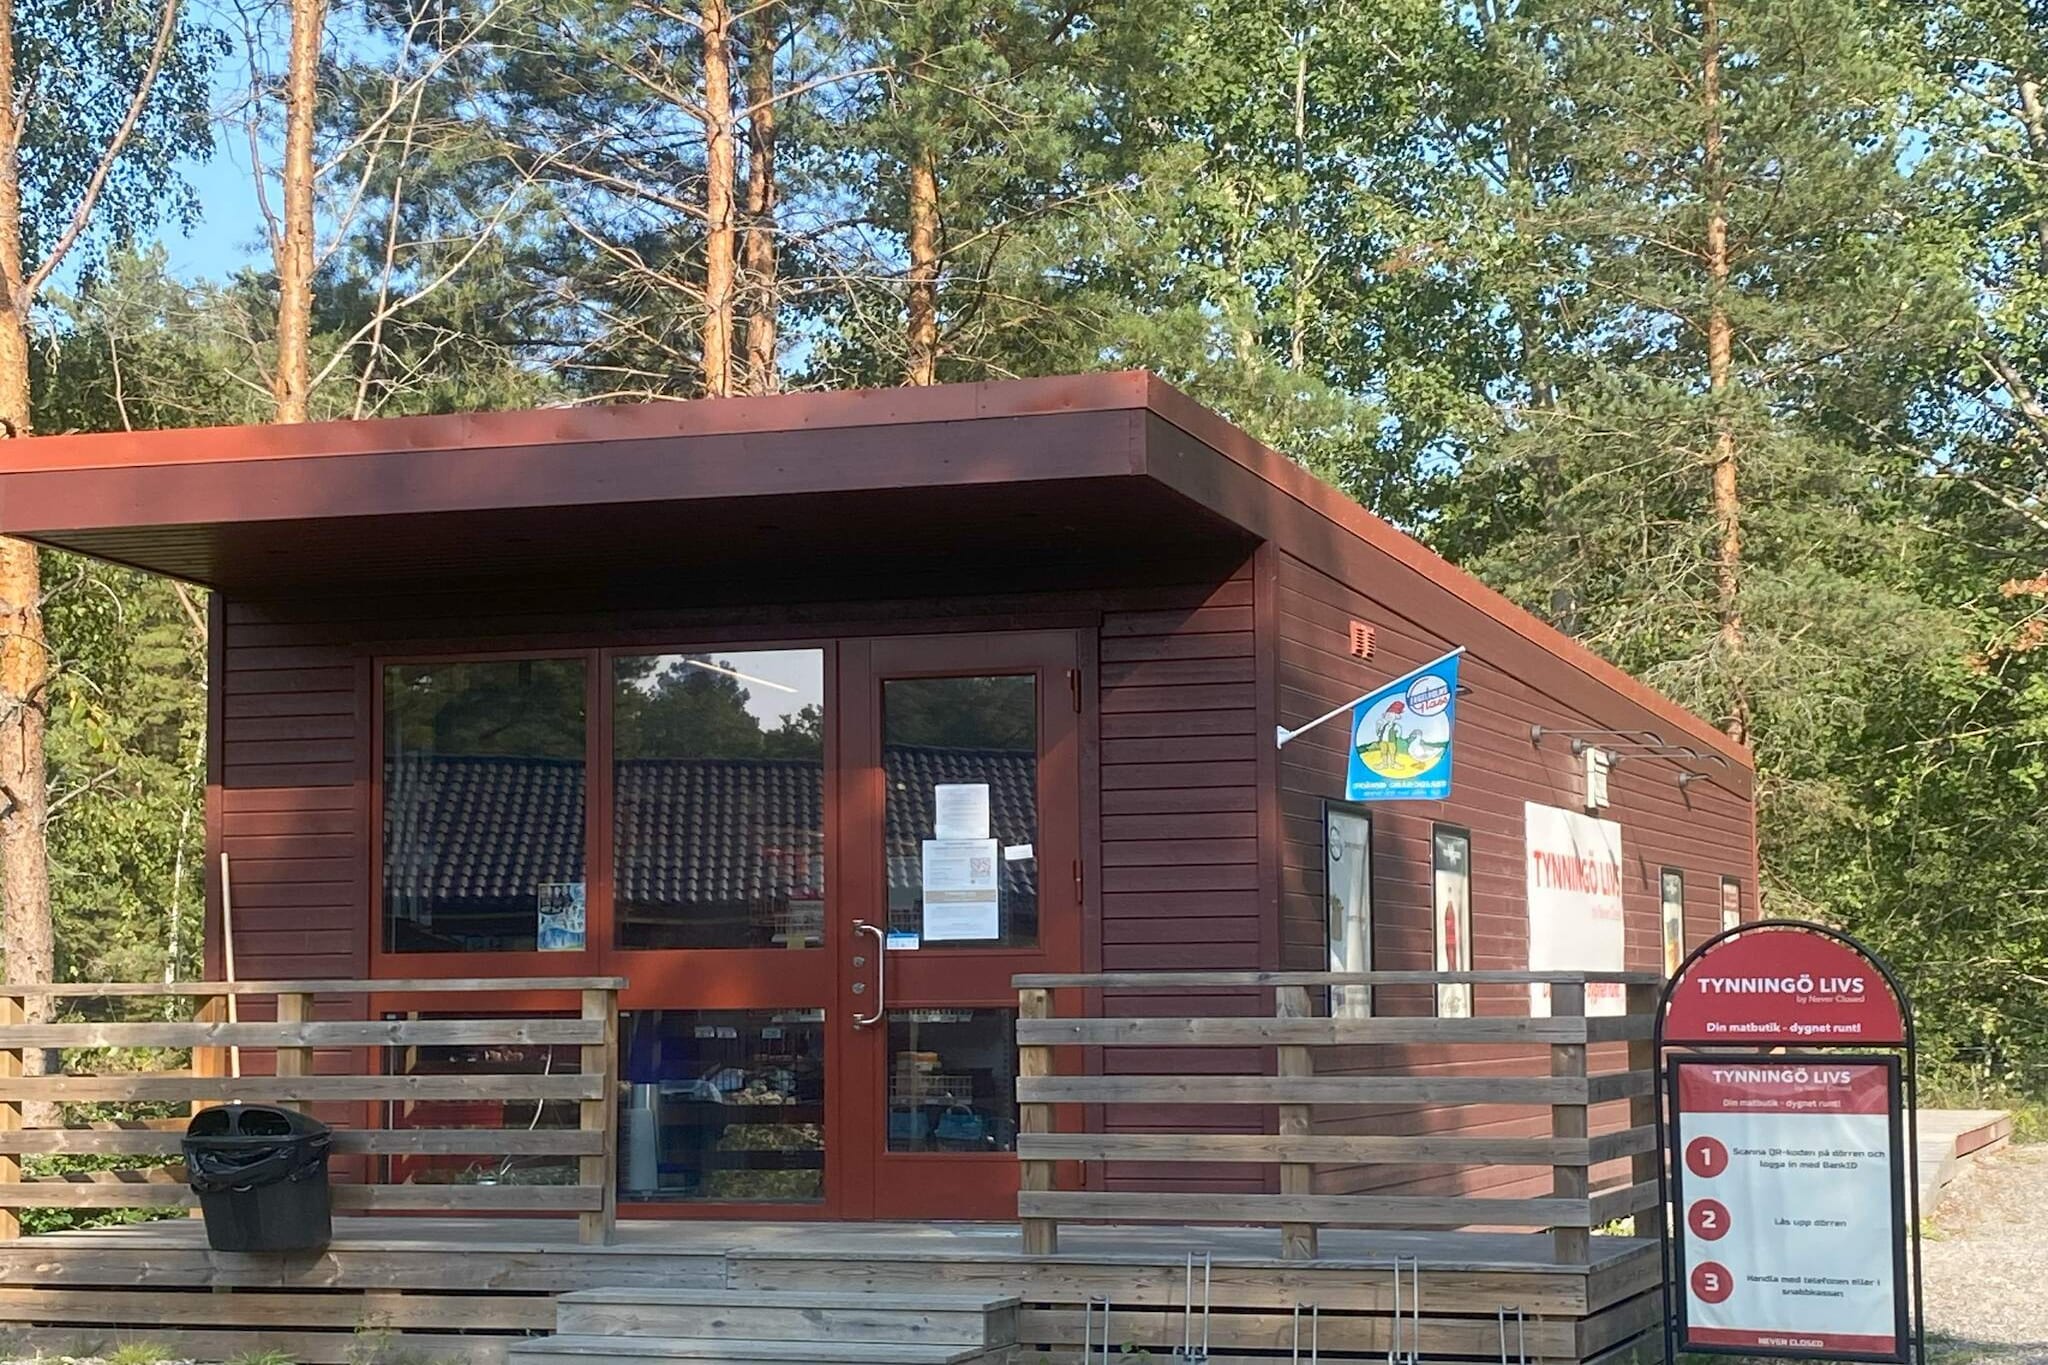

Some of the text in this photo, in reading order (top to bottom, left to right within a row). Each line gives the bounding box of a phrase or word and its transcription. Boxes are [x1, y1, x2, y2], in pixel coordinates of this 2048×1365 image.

[1697, 973, 1865, 994] TYNNINGÖ LIVS
[1706, 1022, 1727, 1033] Din
[1729, 1022, 1781, 1033] matbutik
[1789, 1022, 1832, 1035] dygnet
[1833, 1022, 1862, 1033] runt!
[1712, 1067, 1851, 1084] TYNNINGÖ LIVS
[1722, 1099, 1738, 1108] Din
[1785, 1099, 1817, 1110] dygnet
[1700, 1149, 1711, 1166] 1
[1733, 1147, 1766, 1157] Scanna
[1818, 1148, 1830, 1159] på
[1832, 1148, 1865, 1158] dörren
[1867, 1149, 1886, 1158] och
[1788, 1160, 1797, 1169] in
[1799, 1160, 1820, 1169] med
[1701, 1210, 1717, 1228] 2
[1774, 1217, 1847, 1229] Lås upp dörren
[1704, 1273, 1719, 1291] 3
[1781, 1275, 1801, 1284] med
[1758, 1336, 1824, 1348] NEVER CLOSED
